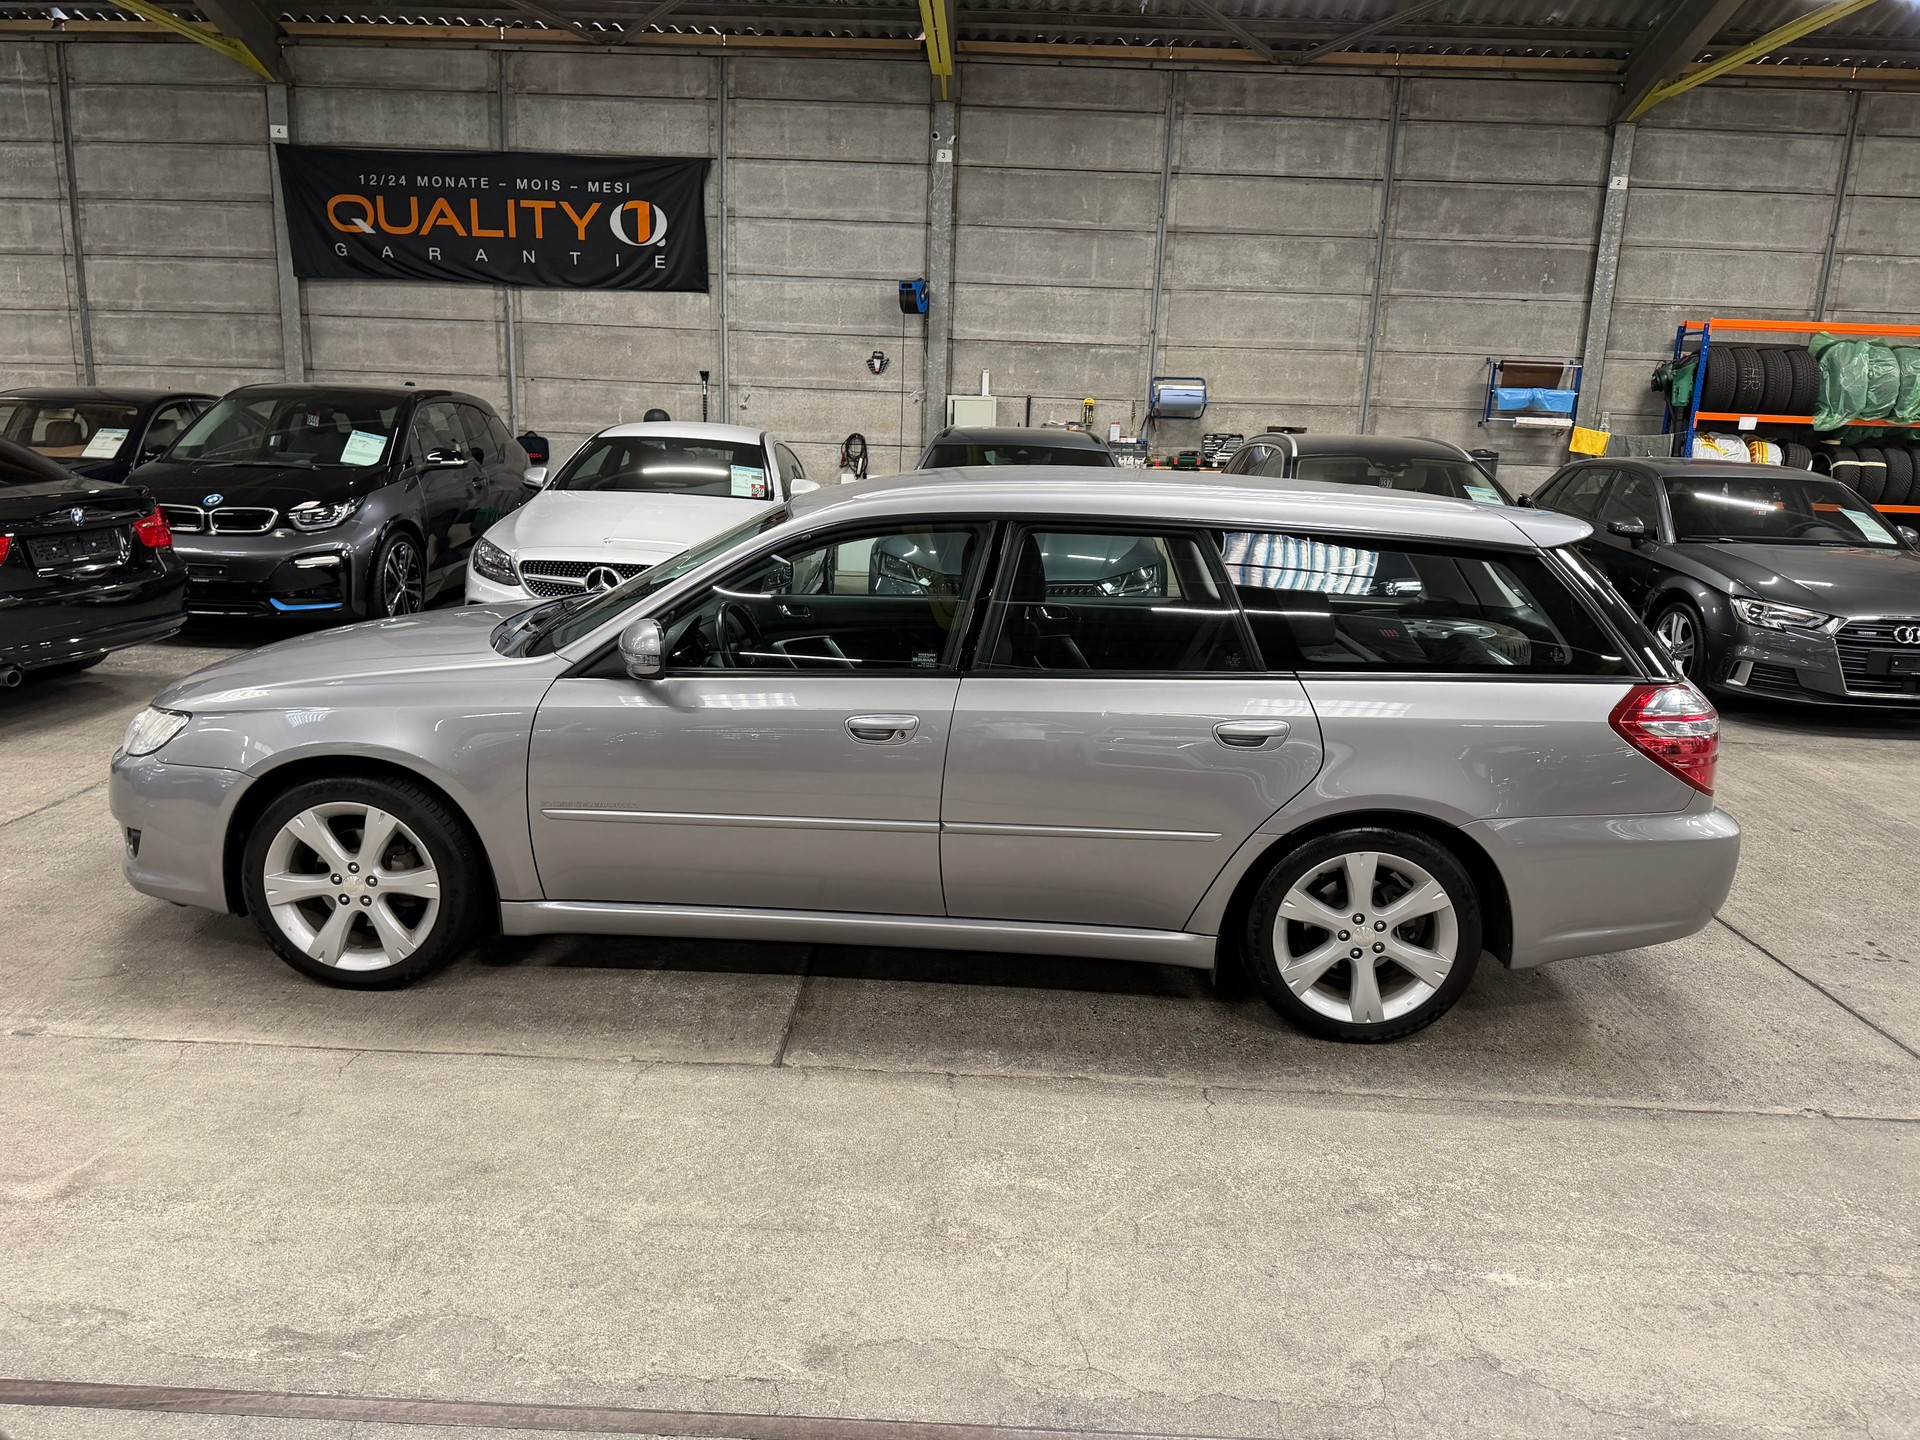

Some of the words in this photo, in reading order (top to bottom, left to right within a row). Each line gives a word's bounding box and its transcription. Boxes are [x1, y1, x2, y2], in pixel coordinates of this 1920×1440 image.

[358, 174, 407, 187] 12/24
[417, 175, 489, 189] MONATE
[516, 178, 561, 192] MOIS
[587, 181, 630, 194] MESI
[327, 193, 602, 241] QUALITY
[334, 242, 666, 269] GARANTIE
